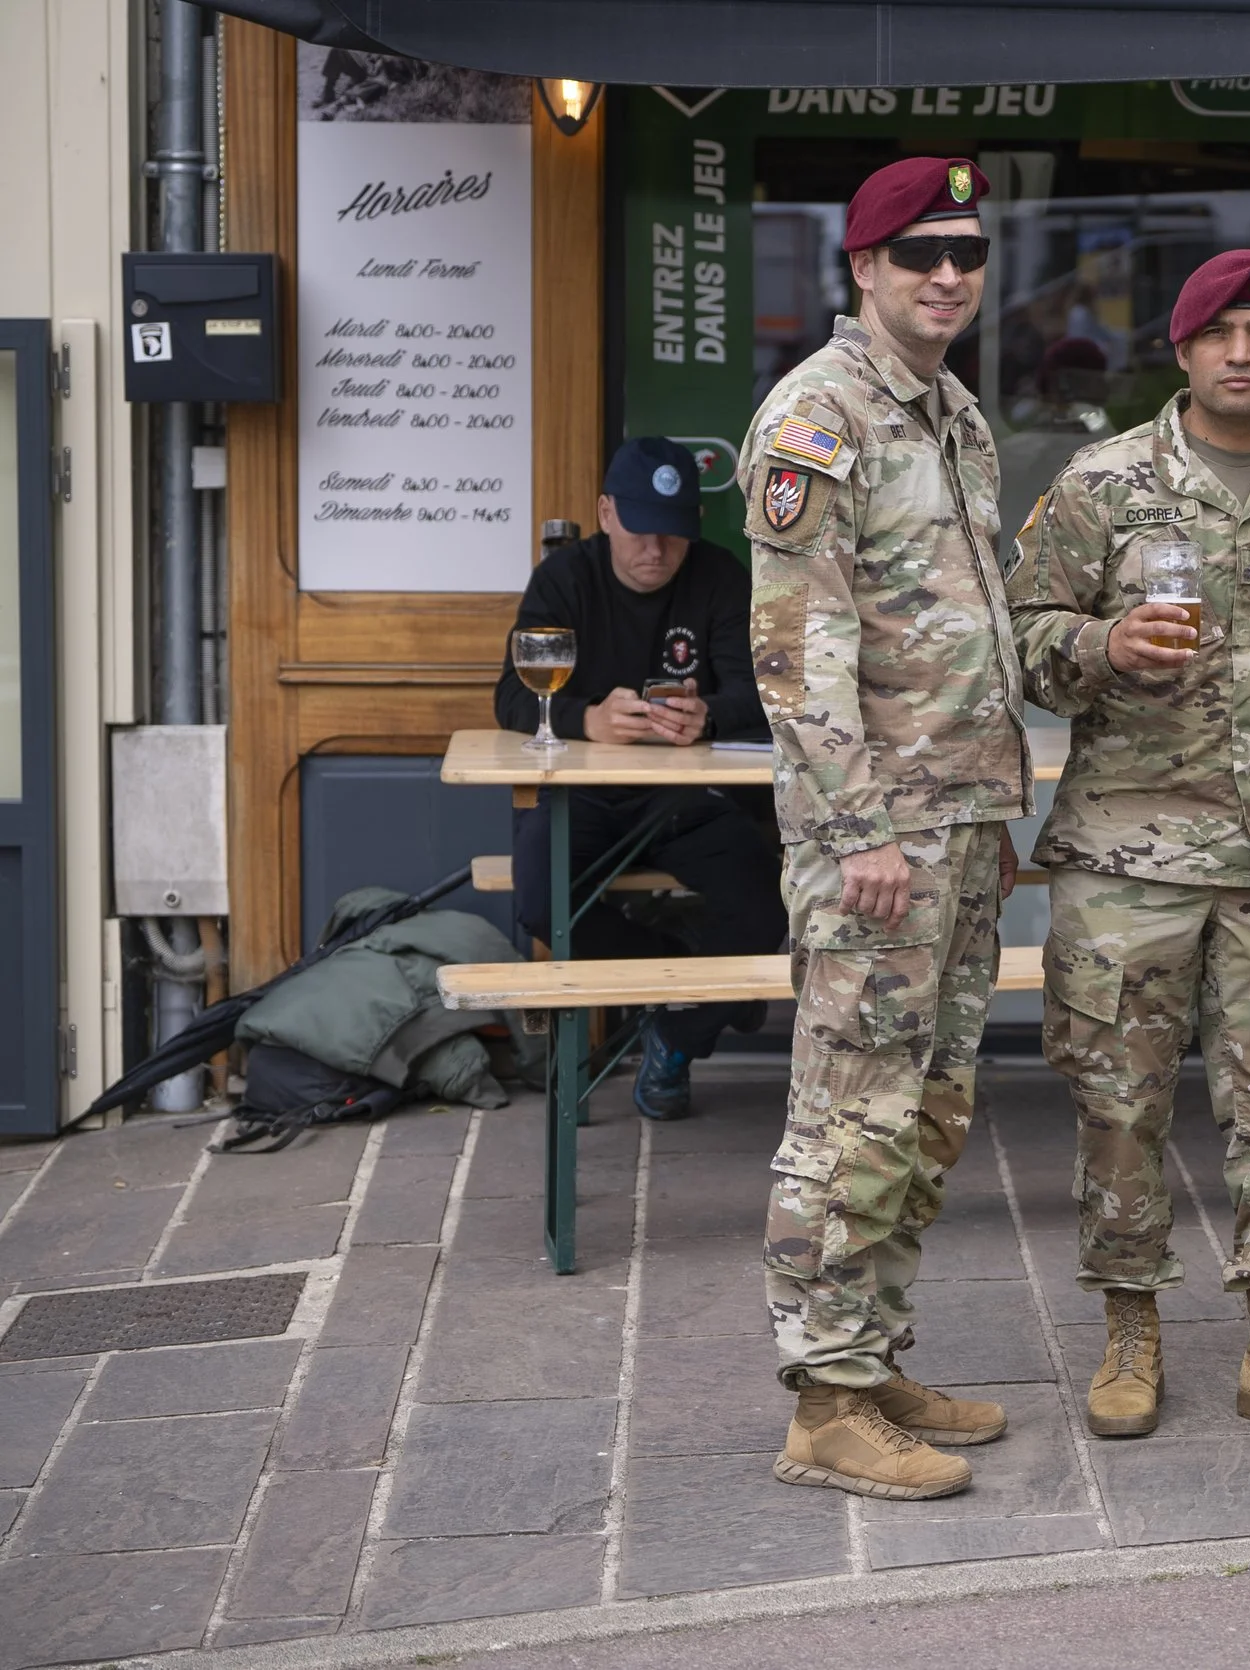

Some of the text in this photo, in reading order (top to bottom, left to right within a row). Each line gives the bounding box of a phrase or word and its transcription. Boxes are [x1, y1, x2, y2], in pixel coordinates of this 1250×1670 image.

[768, 84, 1057, 117] DANS LE JEU
[337, 169, 493, 223] Horaires
[693, 138, 727, 364] DANS LE JEU
[356, 257, 482, 279] Lundi Fermé
[652, 222, 685, 364] ENTREZ
[324, 317, 390, 339] Mardi
[315, 347, 407, 369] Mercredi
[330, 377, 391, 399] Jeudi
[316, 407, 405, 429] Vendredi
[889, 424, 908, 439] BET
[318, 470, 396, 492] Samedi
[314, 500, 413, 522] Dimanche
[1125, 506, 1184, 523] CORREA
